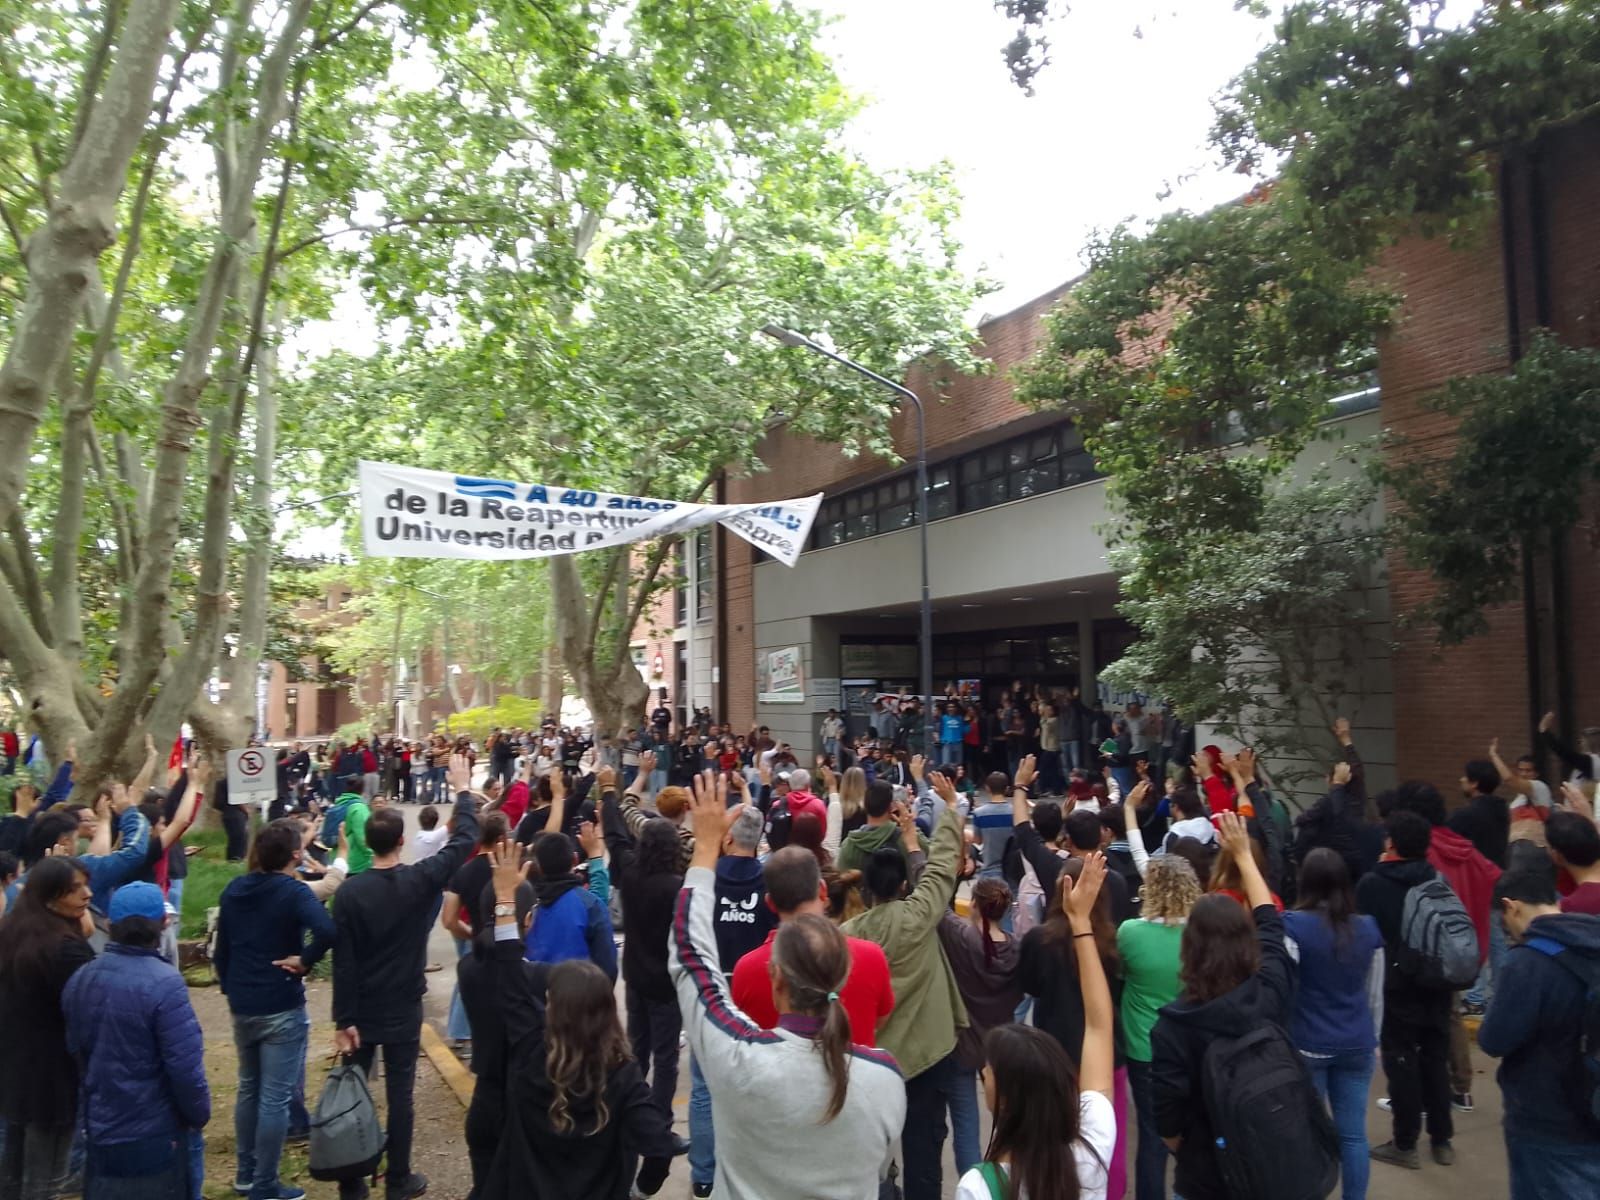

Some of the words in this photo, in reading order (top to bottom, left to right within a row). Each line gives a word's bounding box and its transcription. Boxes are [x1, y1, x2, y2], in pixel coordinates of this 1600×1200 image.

[385, 487, 427, 515] de
[438, 491, 469, 518] la
[526, 485, 548, 504] A
[560, 489, 598, 508] 40
[376, 516, 577, 552] Universidad
[720, 908, 756, 924] AÑOS
